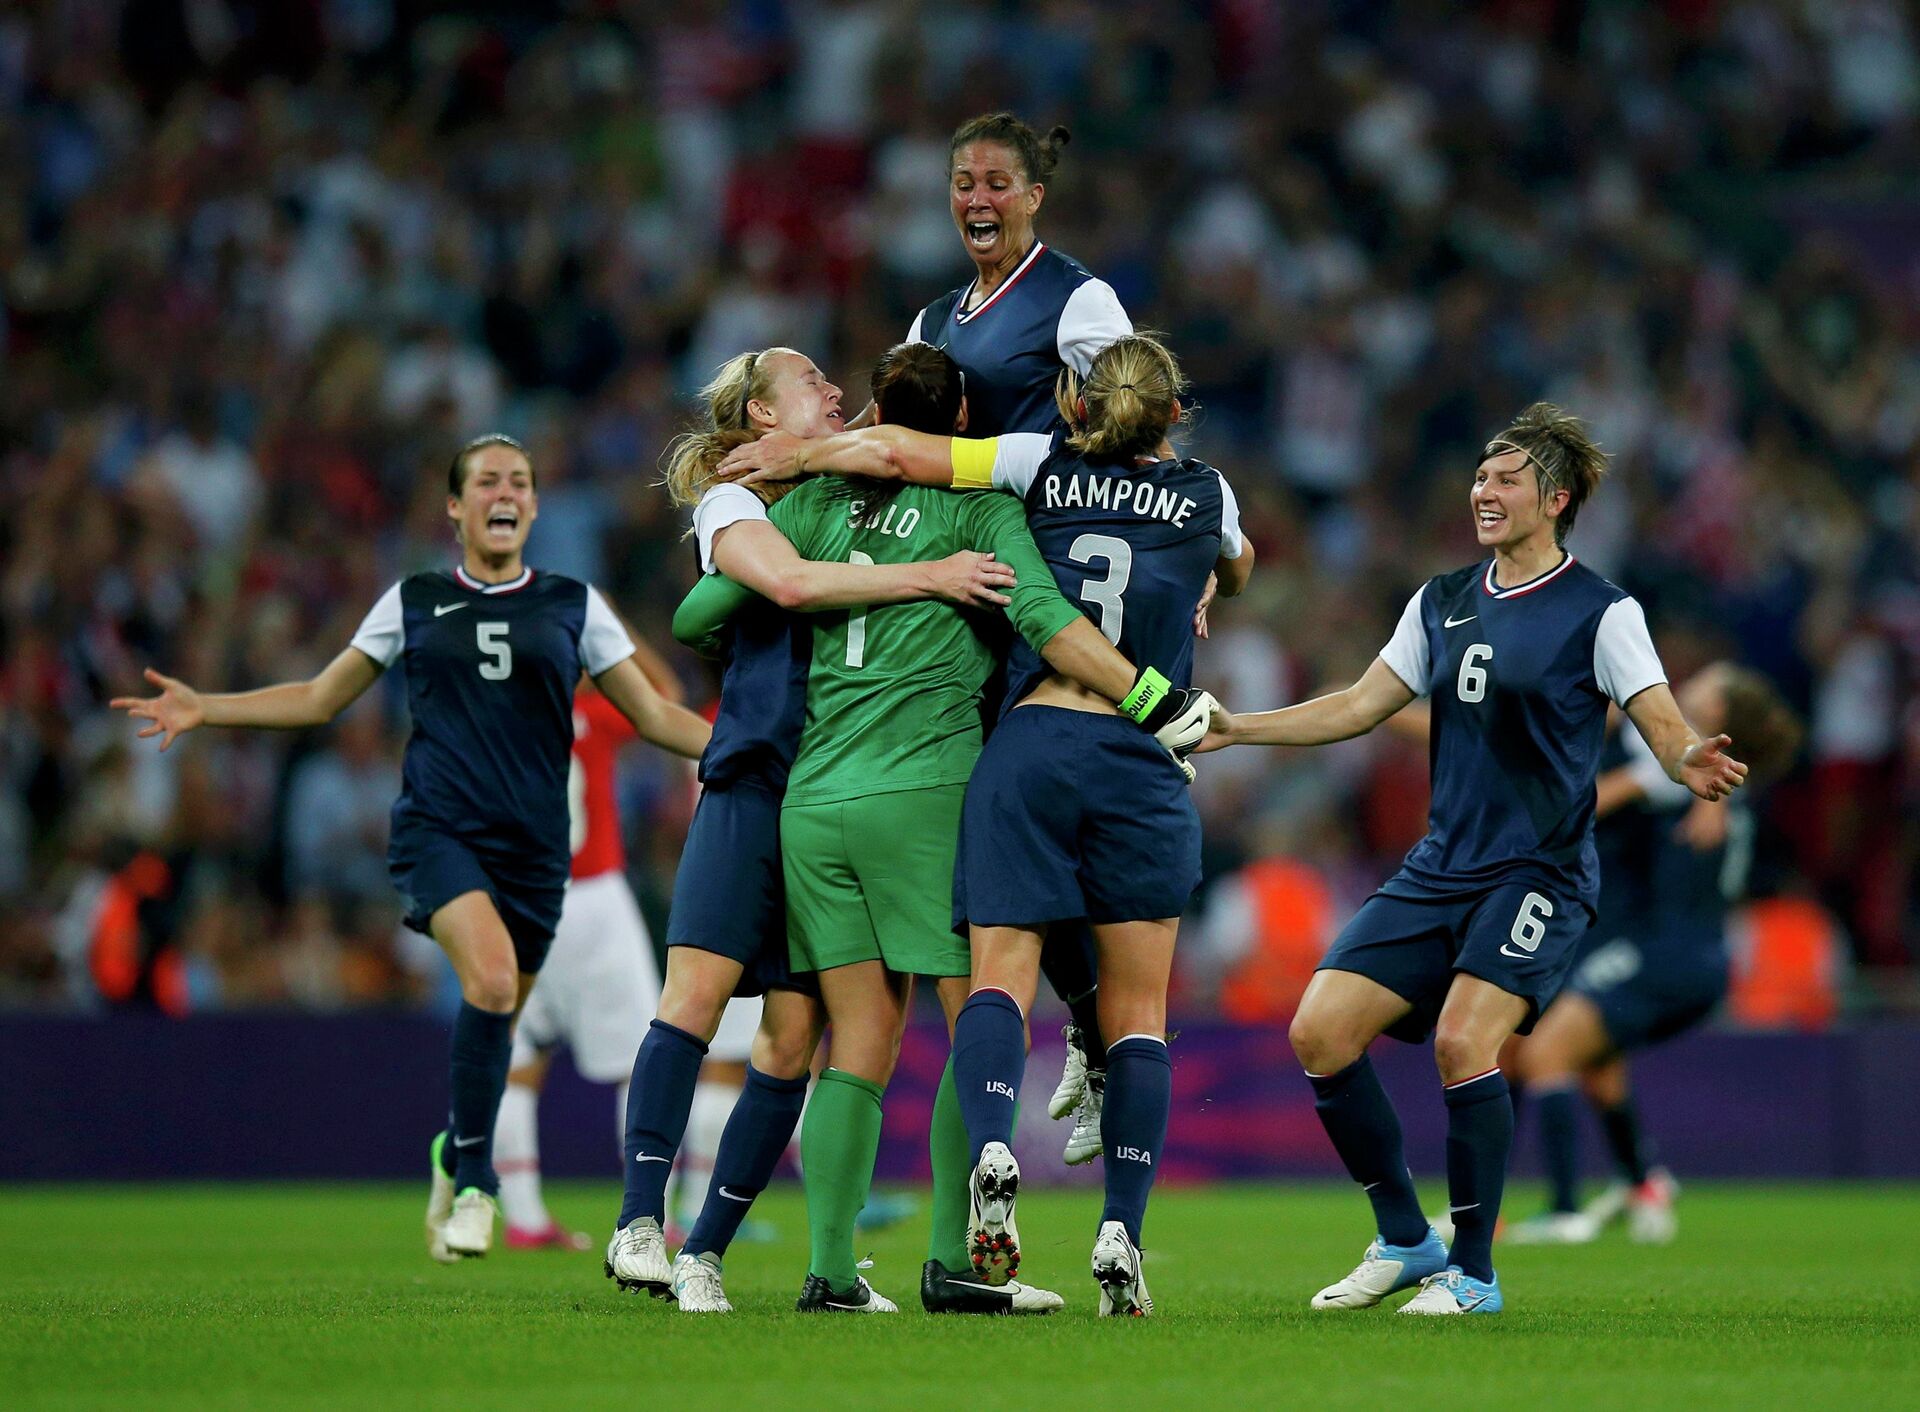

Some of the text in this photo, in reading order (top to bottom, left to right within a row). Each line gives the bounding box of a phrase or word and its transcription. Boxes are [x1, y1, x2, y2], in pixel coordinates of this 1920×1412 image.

[1045, 474, 1197, 529] RAMPONE
[846, 550, 875, 669] 1
[1068, 533, 1132, 647] 3
[476, 622, 512, 681] 5
[1457, 643, 1493, 703] 6
[1511, 892, 1553, 952] 6
[986, 1081, 1014, 1101] USA
[1116, 1146, 1151, 1165] USA
